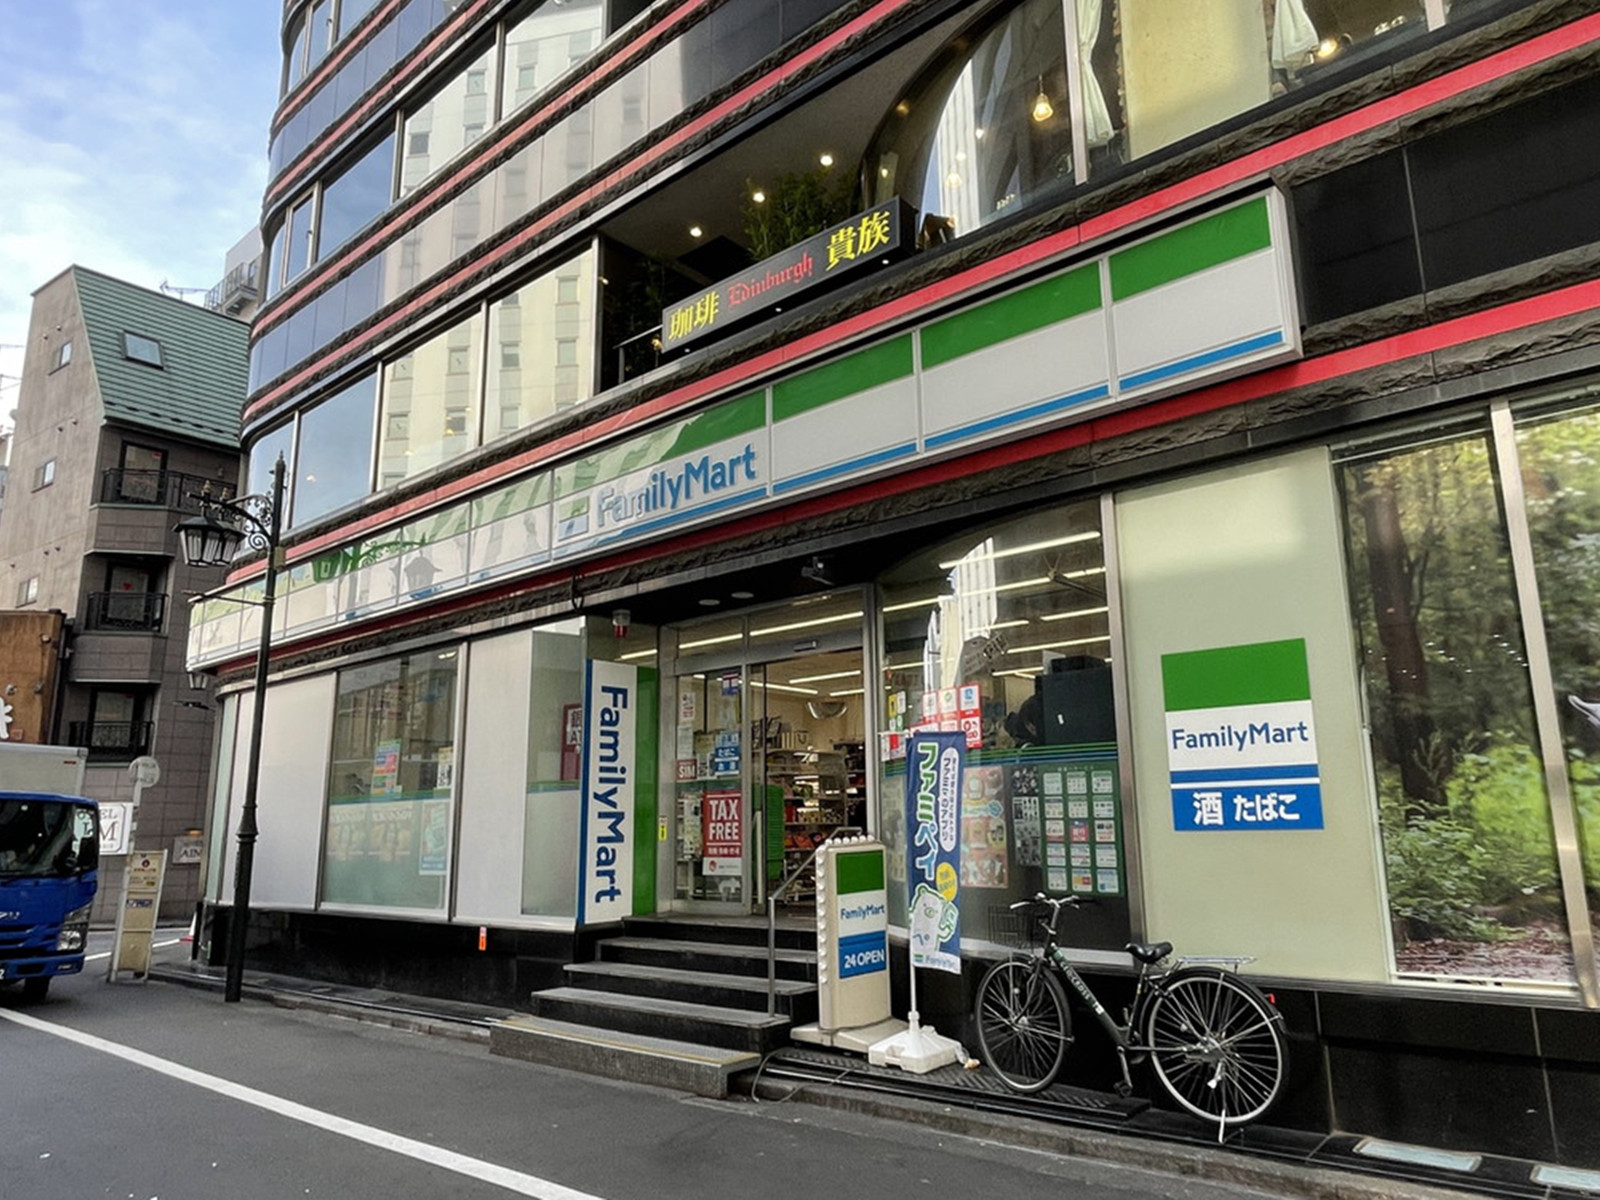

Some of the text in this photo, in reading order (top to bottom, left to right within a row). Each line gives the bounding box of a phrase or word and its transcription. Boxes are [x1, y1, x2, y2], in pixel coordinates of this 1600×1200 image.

[668, 210, 891, 341] 珈琲 Edinburgh 貴族
[597, 443, 757, 528] FamilyMart
[1172, 721, 1309, 752] FamilyMart
[593, 685, 629, 904] FamilyMart
[709, 799, 740, 821] TAX
[1192, 791, 1301, 826] 酒 たばこ
[914, 742, 939, 881] ファミペイ
[708, 821, 740, 841] FREE
[840, 904, 885, 920] FamilyMart
[844, 948, 885, 969] 24 OPEN
